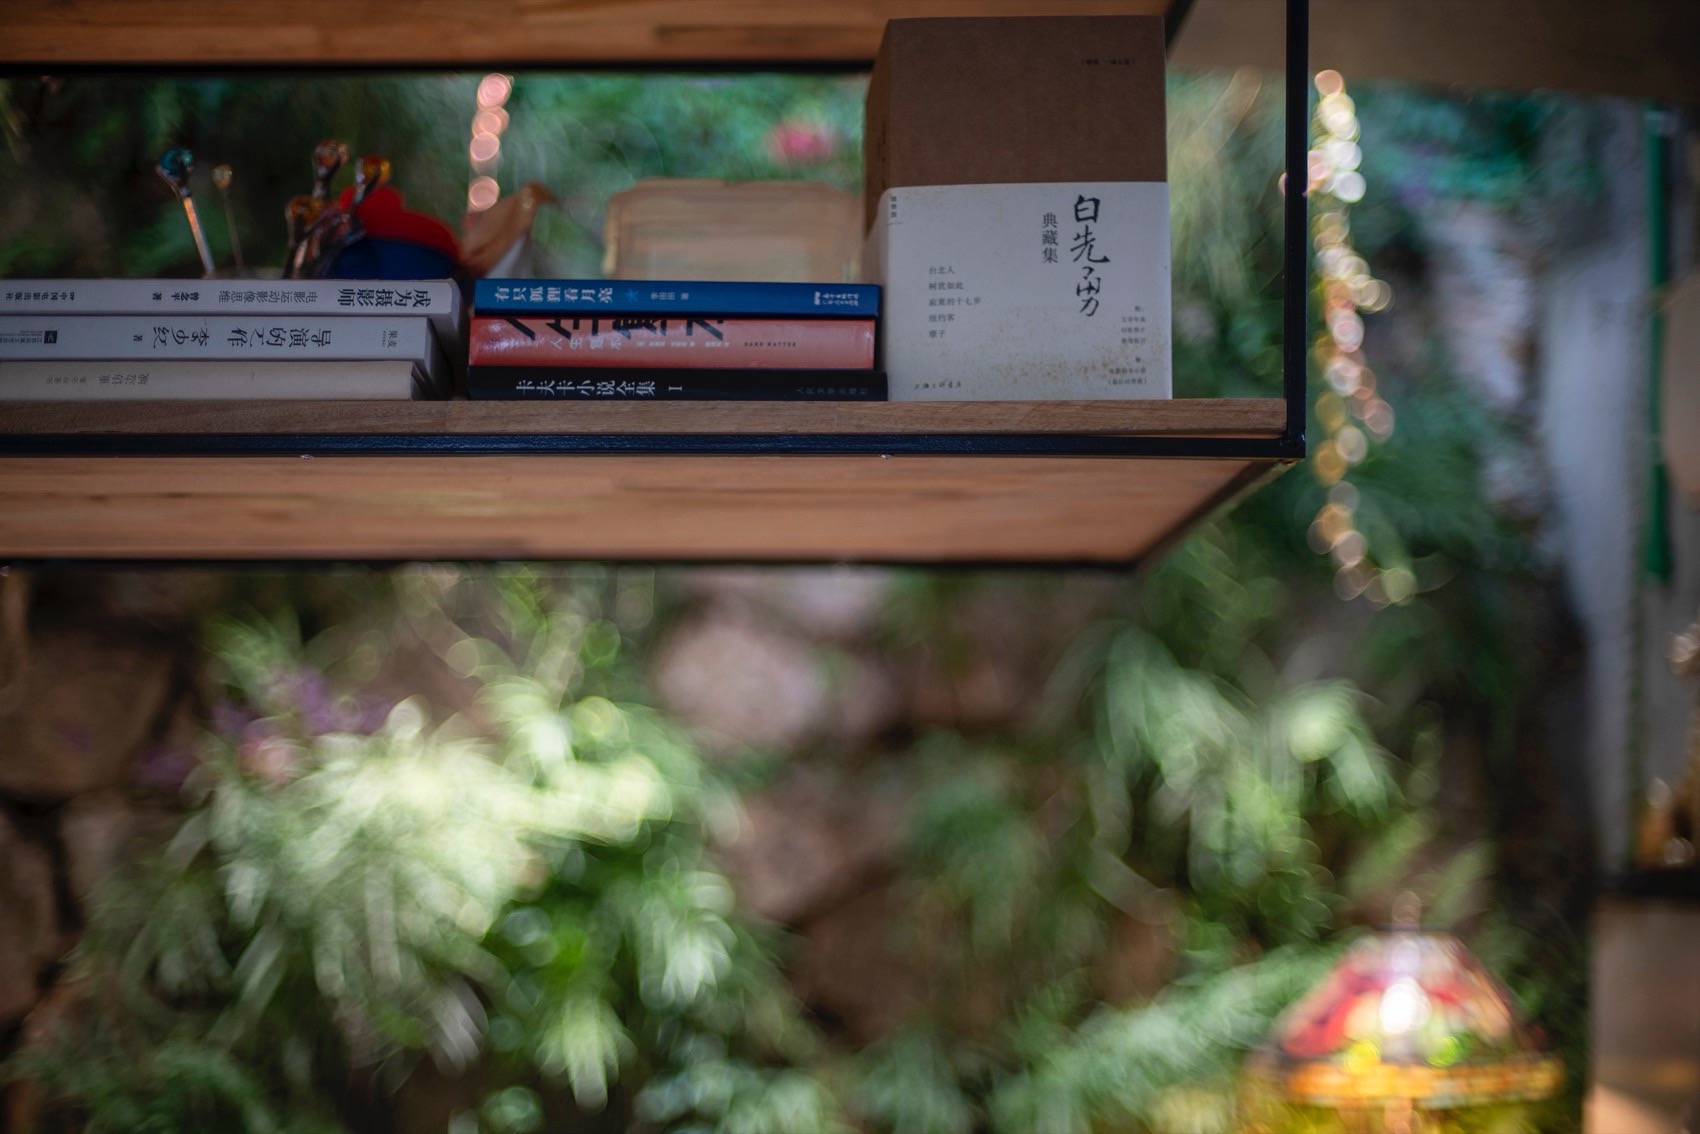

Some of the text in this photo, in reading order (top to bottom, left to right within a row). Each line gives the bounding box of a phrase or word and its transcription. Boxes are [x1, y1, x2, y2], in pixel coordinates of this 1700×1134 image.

[1042, 212, 1058, 264] 典藏集
[1071, 195, 1110, 316] 白先勇
[928, 265, 955, 275] 台北人
[928, 281, 964, 291] 树犹如此
[6, 291, 67, 301] 中国电影出版社
[152, 291, 200, 302] 曾念平 著
[219, 290, 319, 304] 电影运动影像思维
[338, 288, 431, 307] 成为摄影师
[494, 286, 613, 304] 有只狐狸看月亮
[928, 296, 982, 307] 寂寞的十七岁
[928, 313, 955, 323] 纽约客
[224, 327, 332, 348] 导演的工作
[387, 330, 398, 348] 果麦
[98, 373, 150, 385] 重访边城
[516, 380, 656, 396] 卡夫卡小说全集
